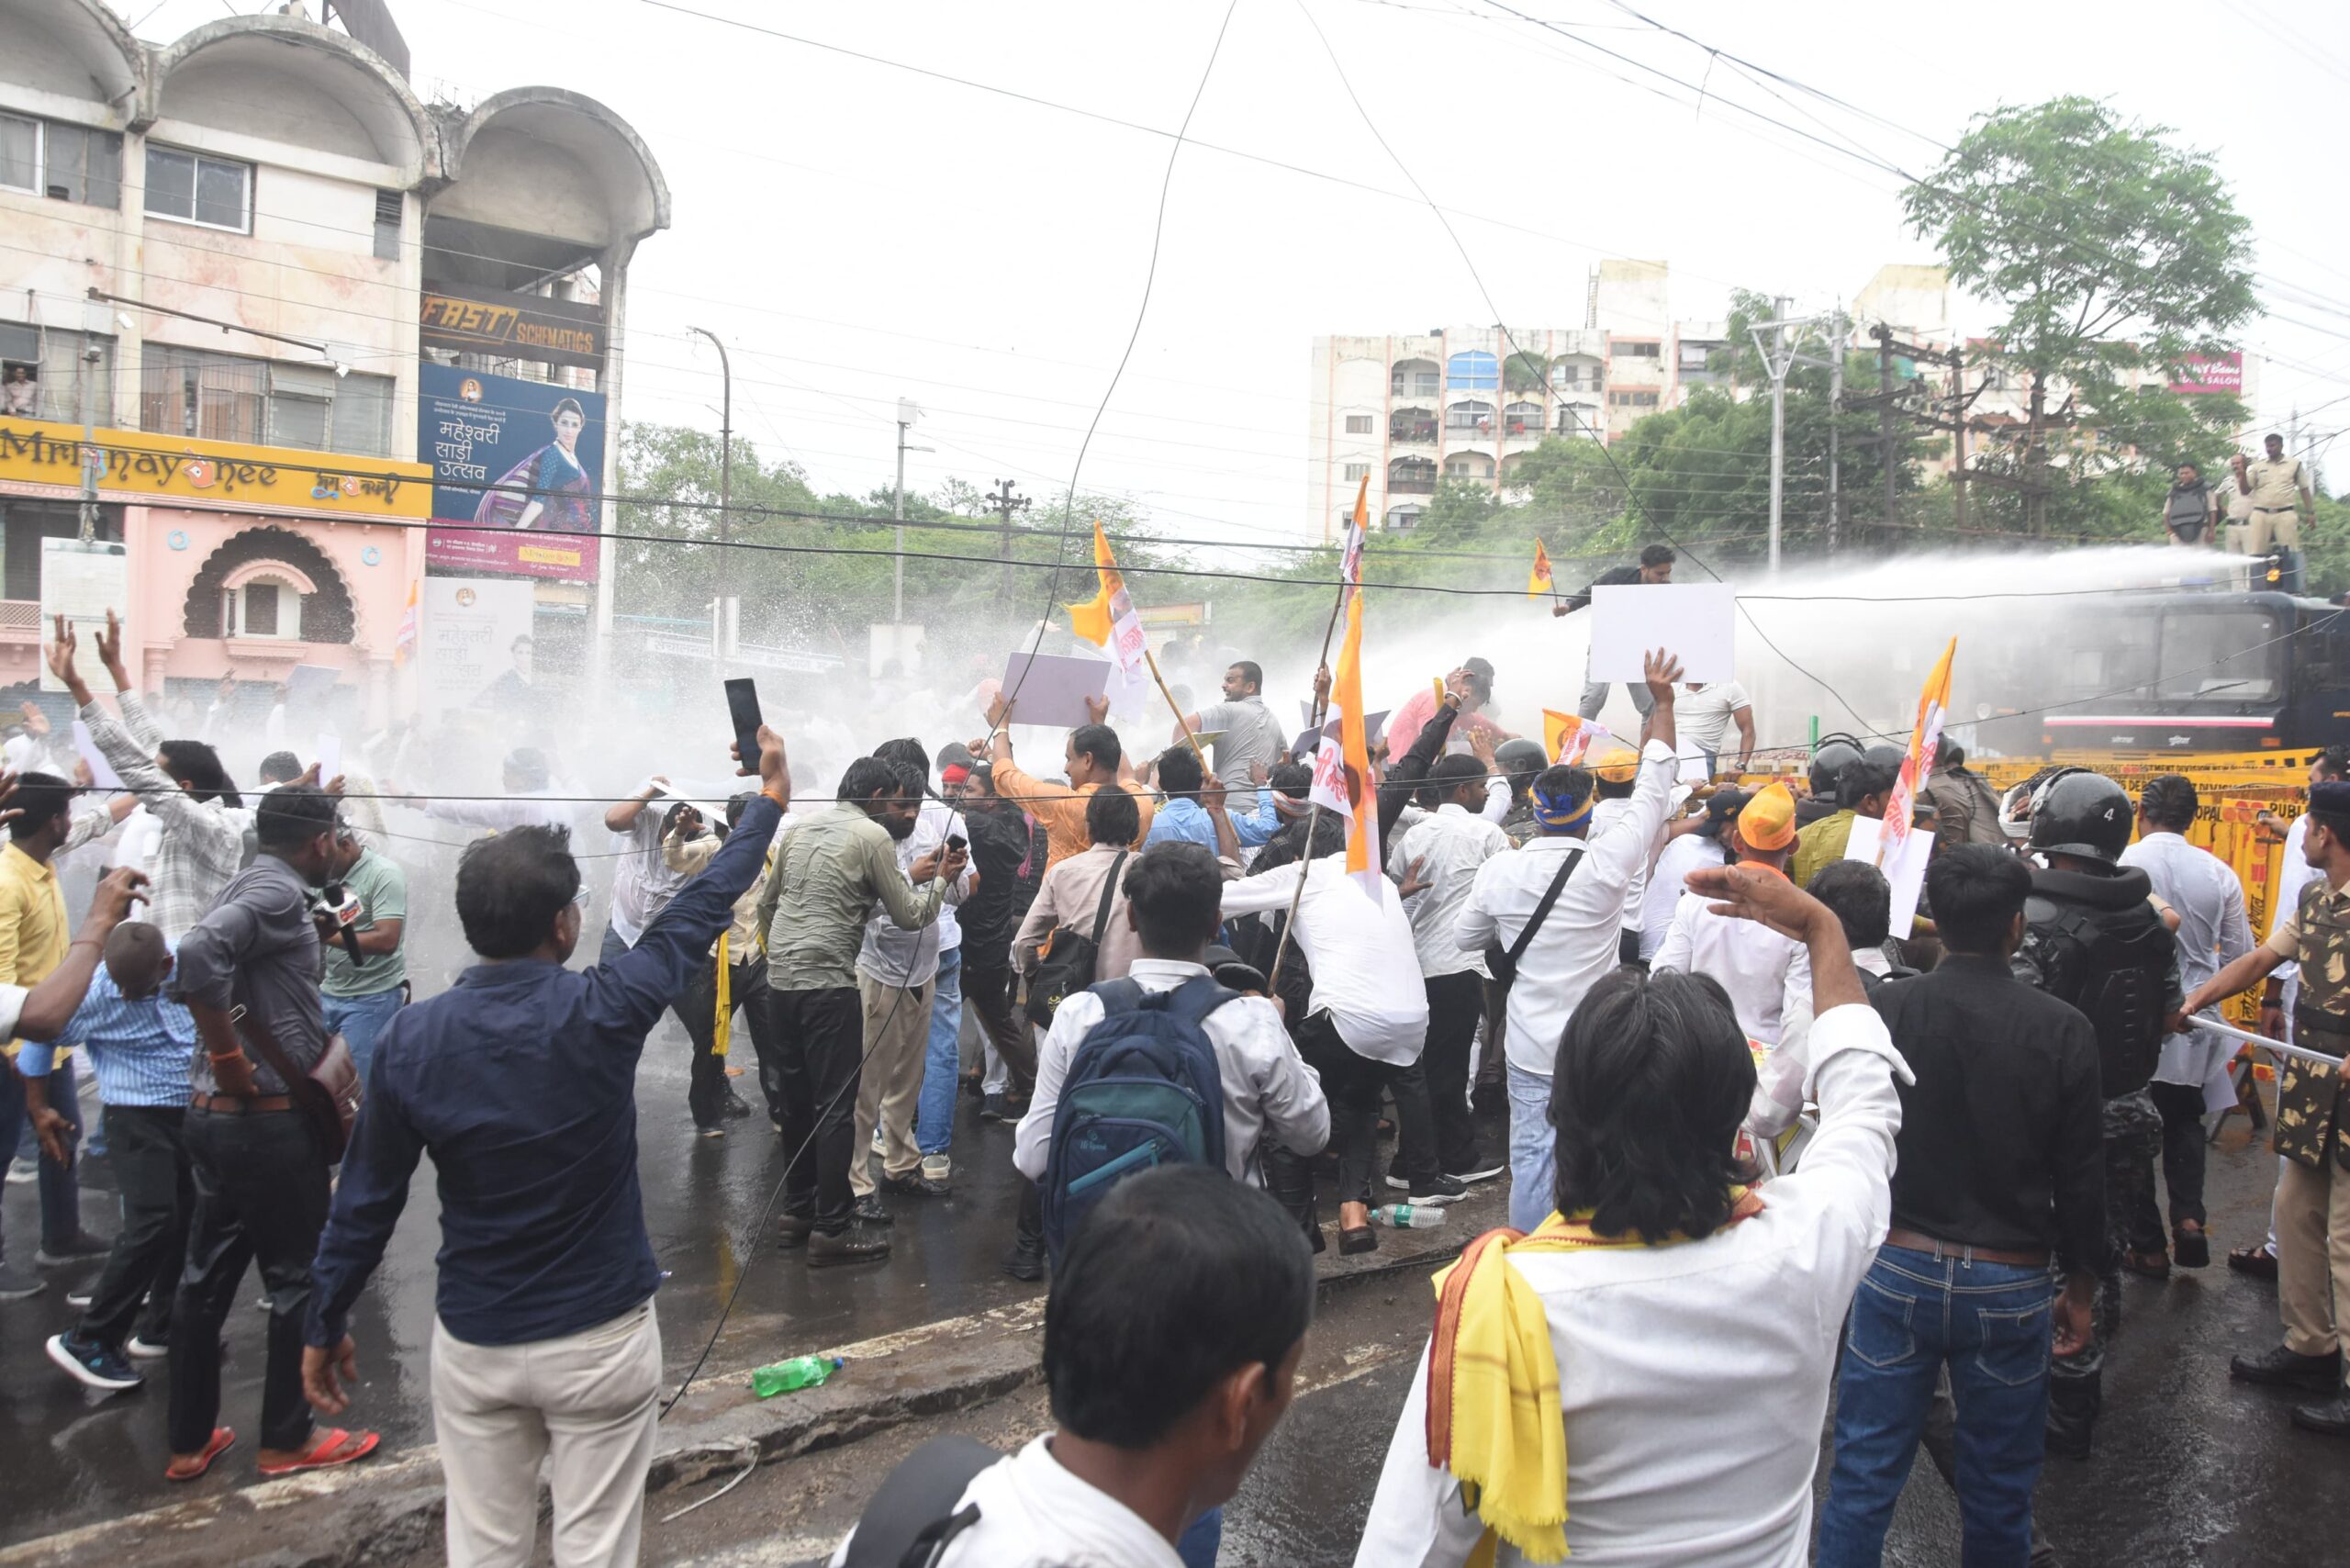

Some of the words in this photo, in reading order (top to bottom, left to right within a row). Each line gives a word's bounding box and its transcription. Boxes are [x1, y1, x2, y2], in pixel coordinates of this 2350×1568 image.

[420, 296, 515, 332] FAST
[517, 322, 594, 353] SCHEMATICS
[2207, 375, 2241, 386] SALON
[439, 417, 501, 445] महेश्वरी
[439, 460, 487, 481] उत्सव
[2103, 808, 2114, 822] 4
[2195, 805, 2222, 823] OPAL
